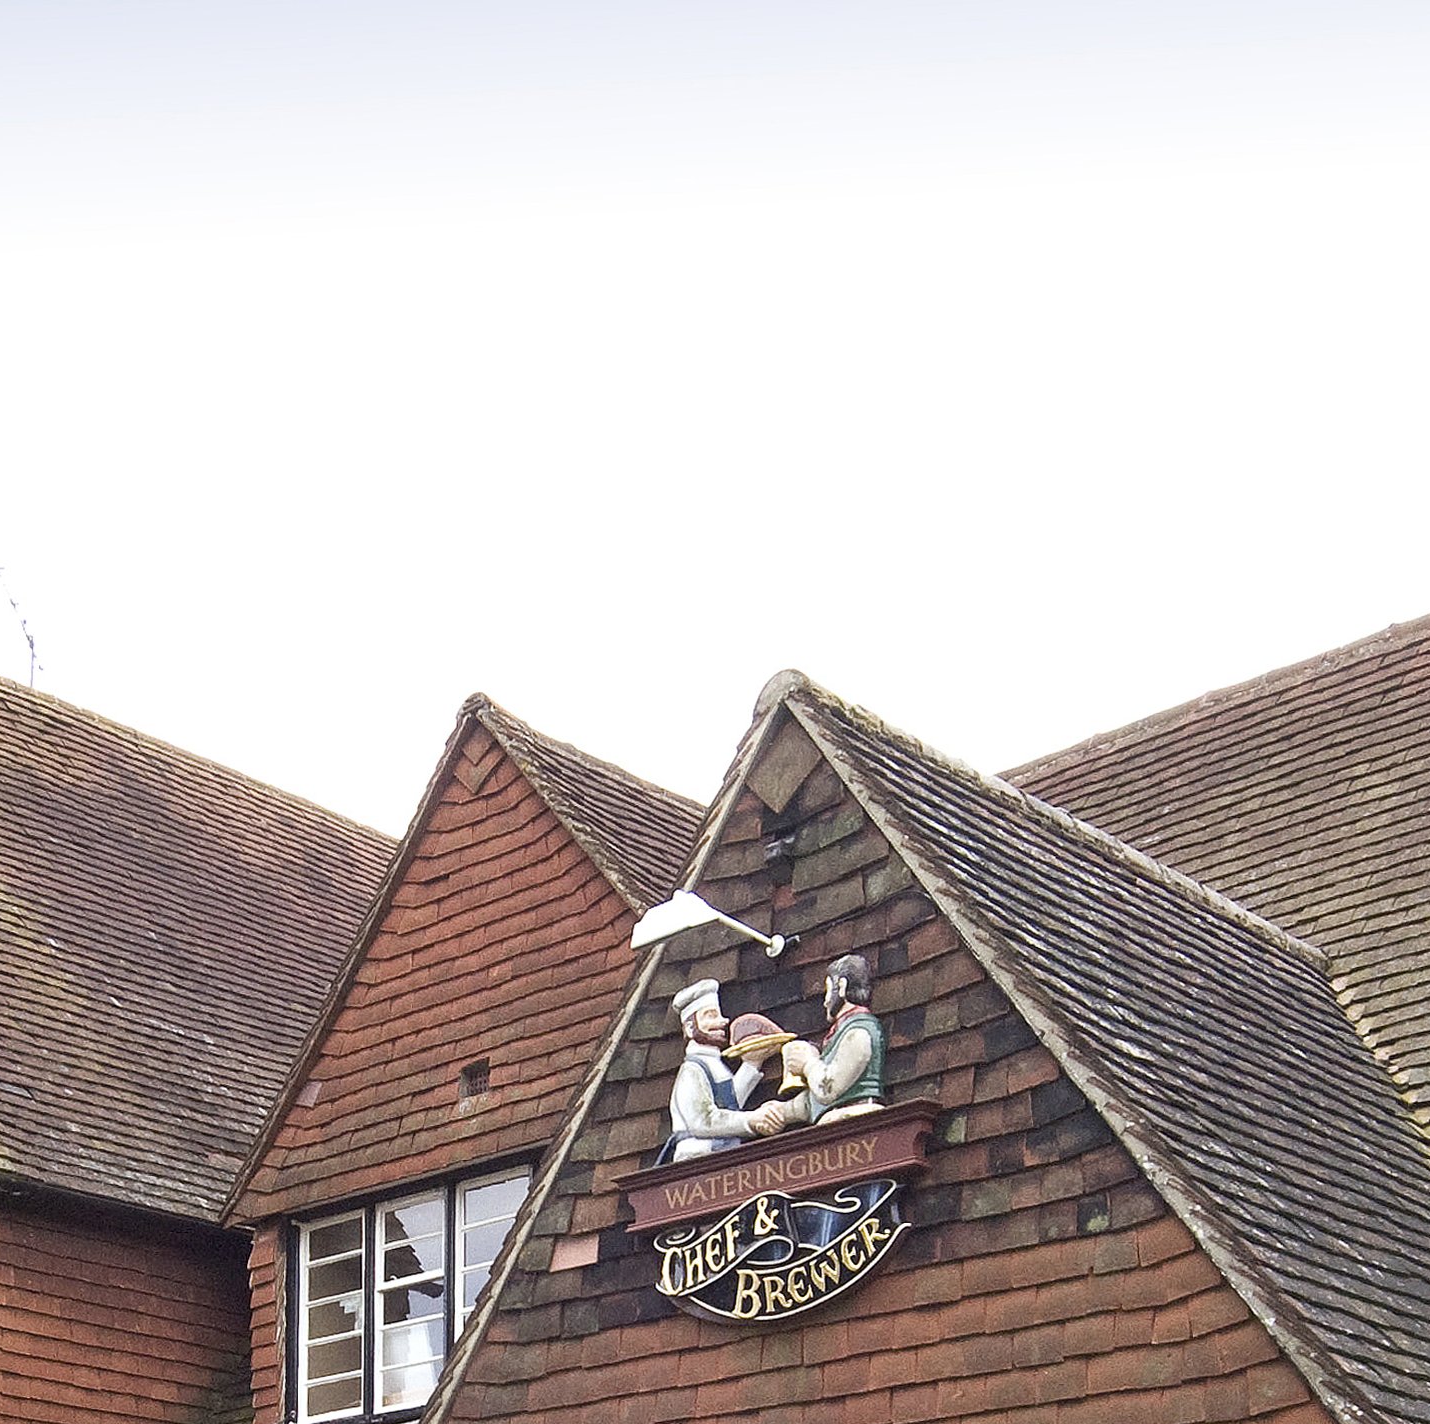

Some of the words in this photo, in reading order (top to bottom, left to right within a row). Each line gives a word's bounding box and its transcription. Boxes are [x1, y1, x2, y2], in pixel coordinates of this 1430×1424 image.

[664, 1136, 879, 1209] WATERINGBURY
[661, 1215, 741, 1297] CHEF
[753, 1197, 781, 1236] &
